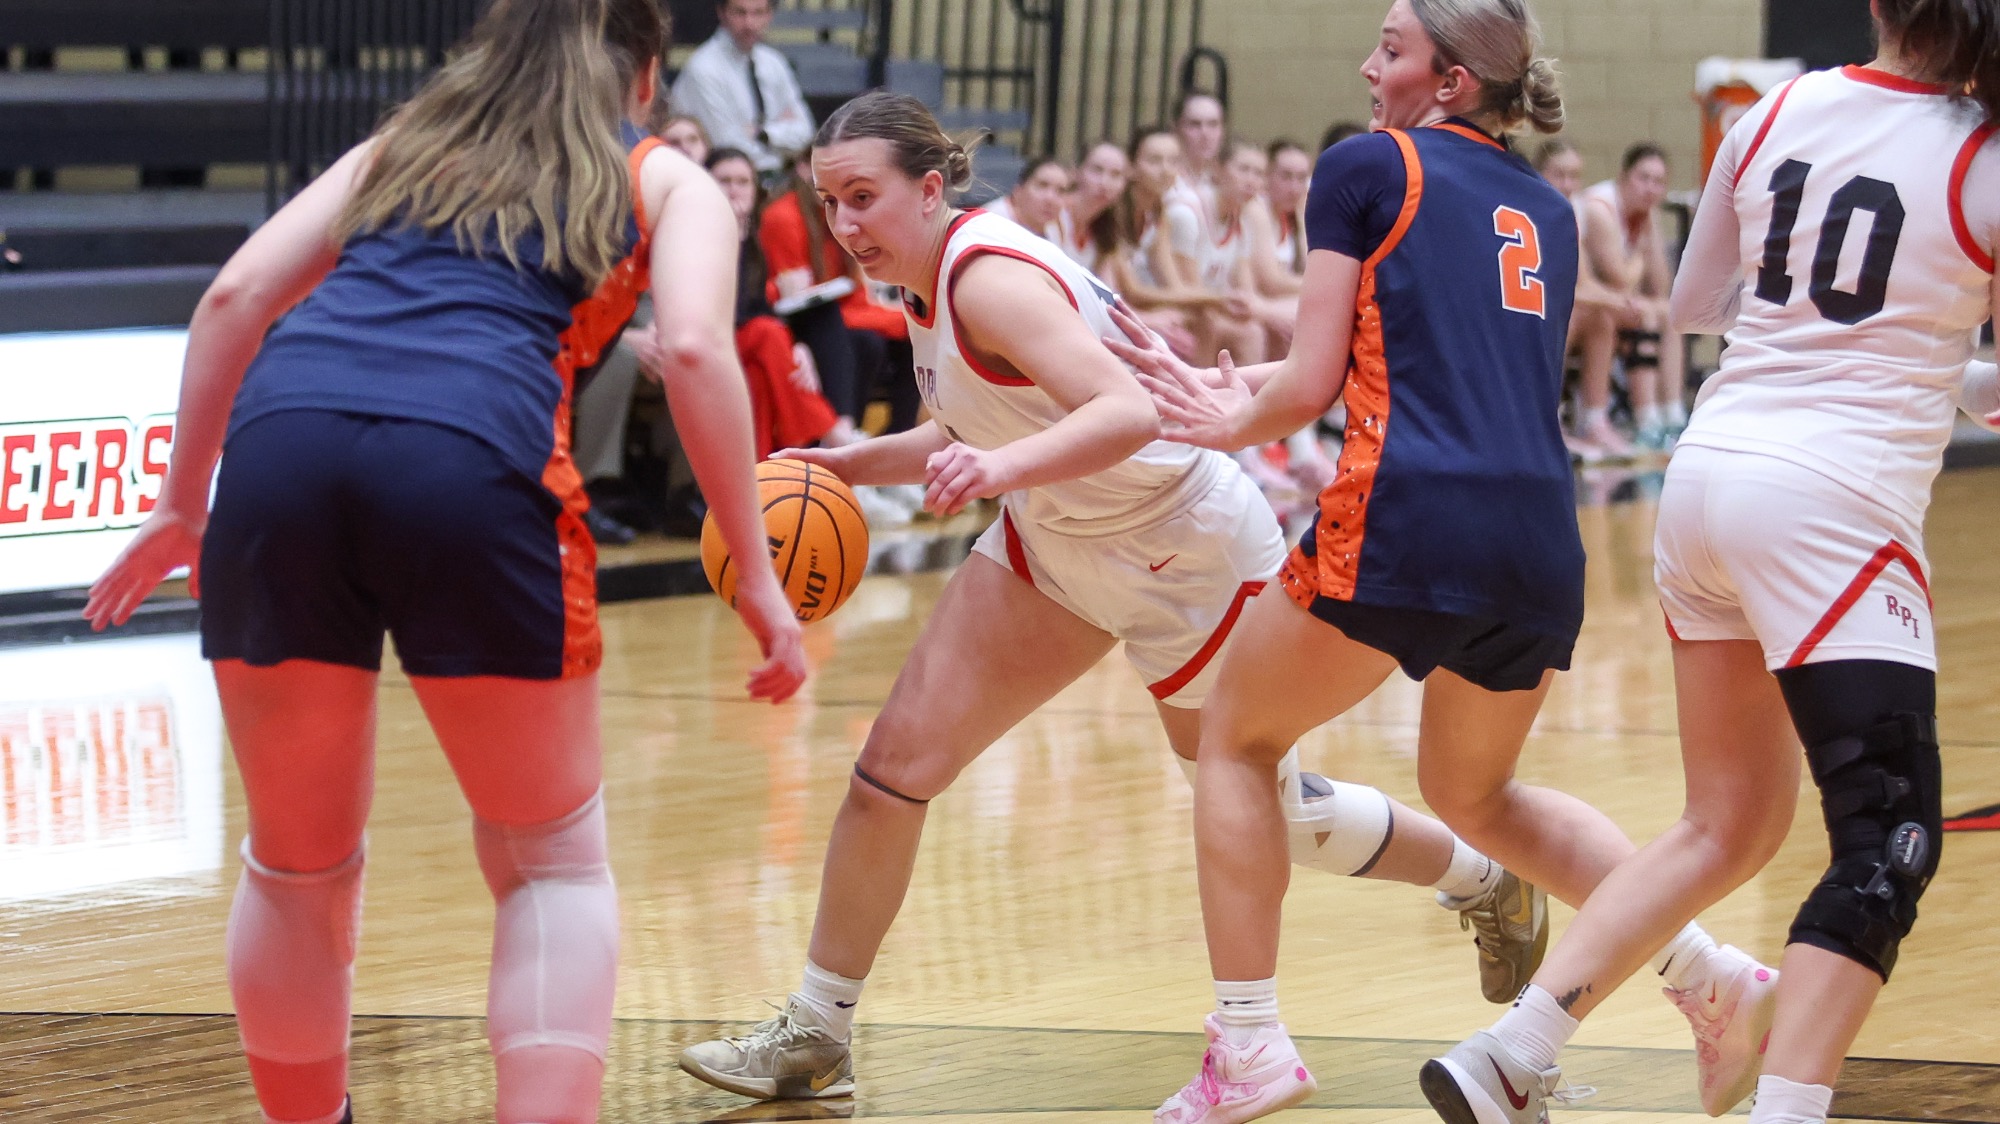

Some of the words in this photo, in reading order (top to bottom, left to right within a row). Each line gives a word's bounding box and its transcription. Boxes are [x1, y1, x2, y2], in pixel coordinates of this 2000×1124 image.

[1492, 204, 1545, 320] 2
[1754, 158, 1906, 325] 10
[0, 425, 174, 524] EERS
[795, 570, 827, 621] EVO
[1884, 594, 1920, 639] RPI
